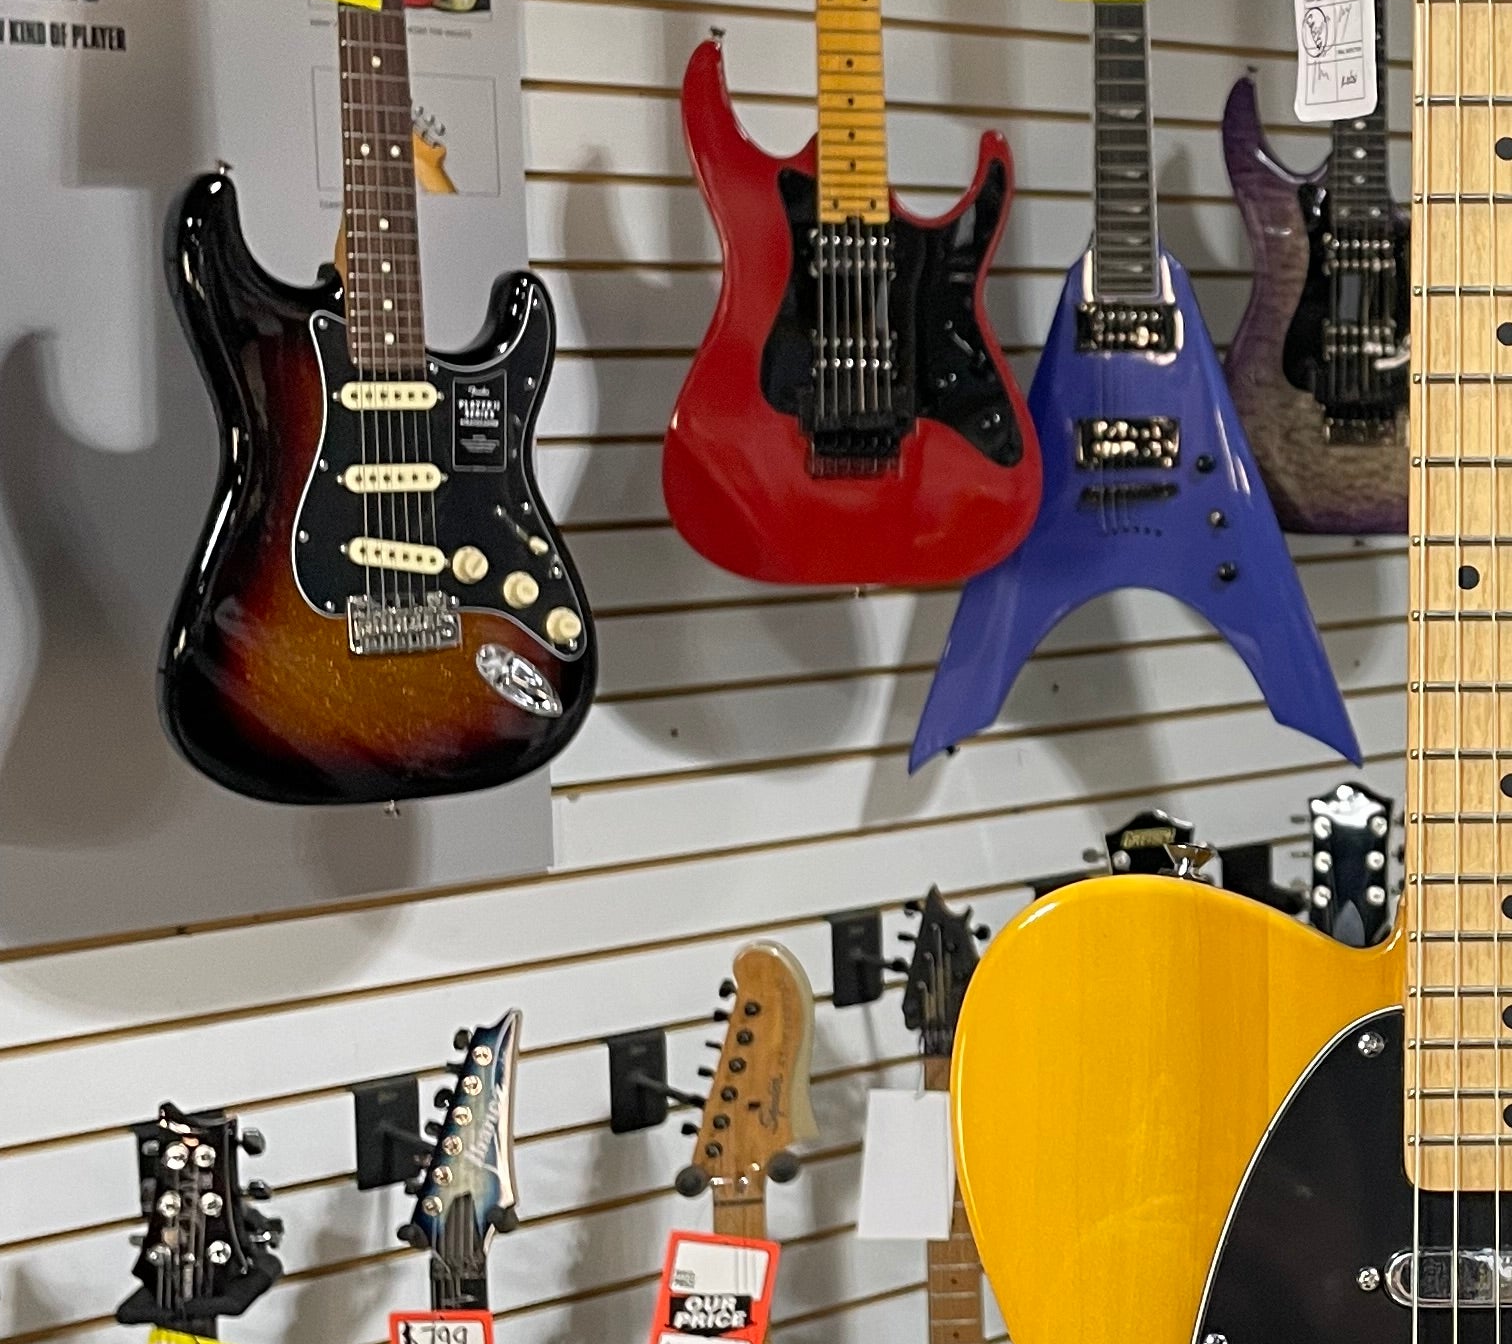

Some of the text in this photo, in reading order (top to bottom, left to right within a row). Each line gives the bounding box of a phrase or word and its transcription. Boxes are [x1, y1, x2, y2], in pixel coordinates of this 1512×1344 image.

[50, 21, 67, 49] OF
[72, 22, 127, 52] PLAYER
[684, 1294, 737, 1315] OUR
[673, 1306, 747, 1330] PRICE
